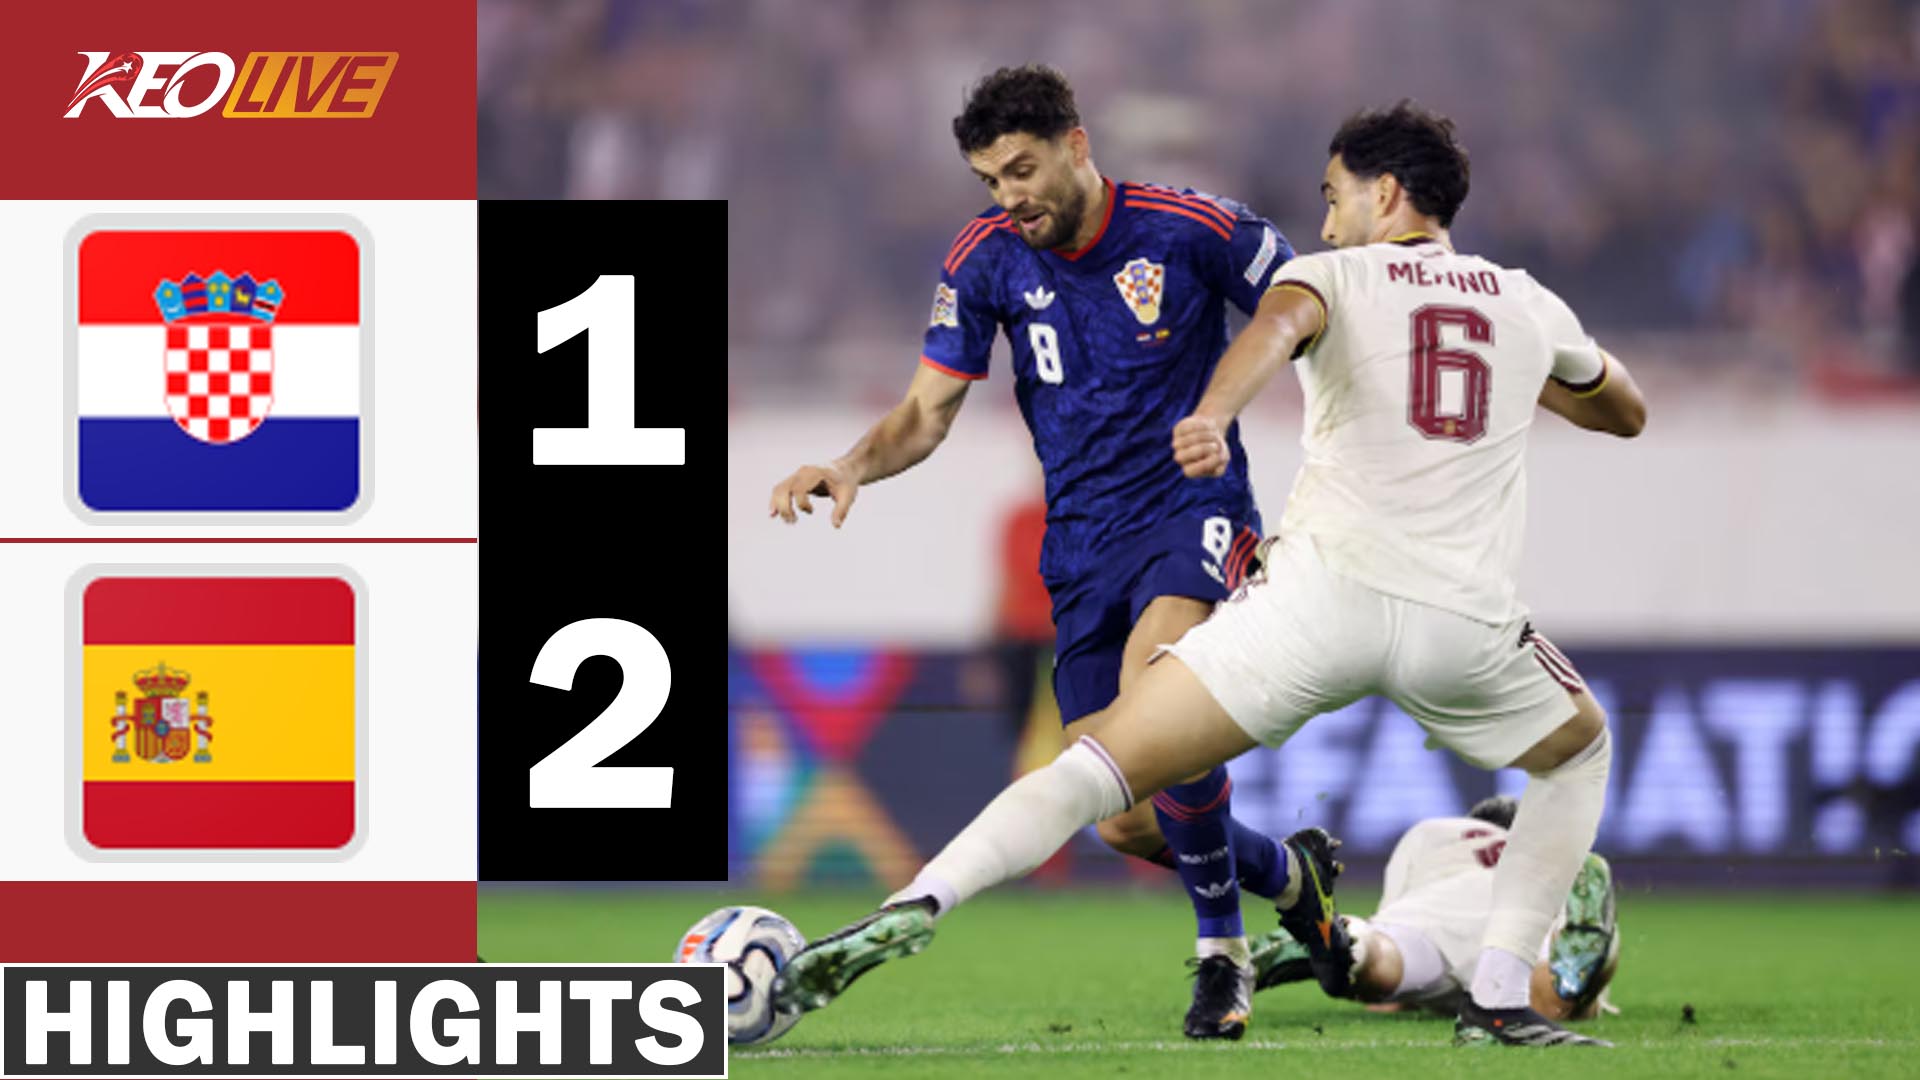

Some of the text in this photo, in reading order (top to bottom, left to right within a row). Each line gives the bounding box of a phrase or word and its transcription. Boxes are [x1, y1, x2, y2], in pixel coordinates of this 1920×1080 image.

[1028, 323, 1064, 384] 8
[1408, 303, 1495, 444] 6
[1201, 516, 1232, 568] 8
